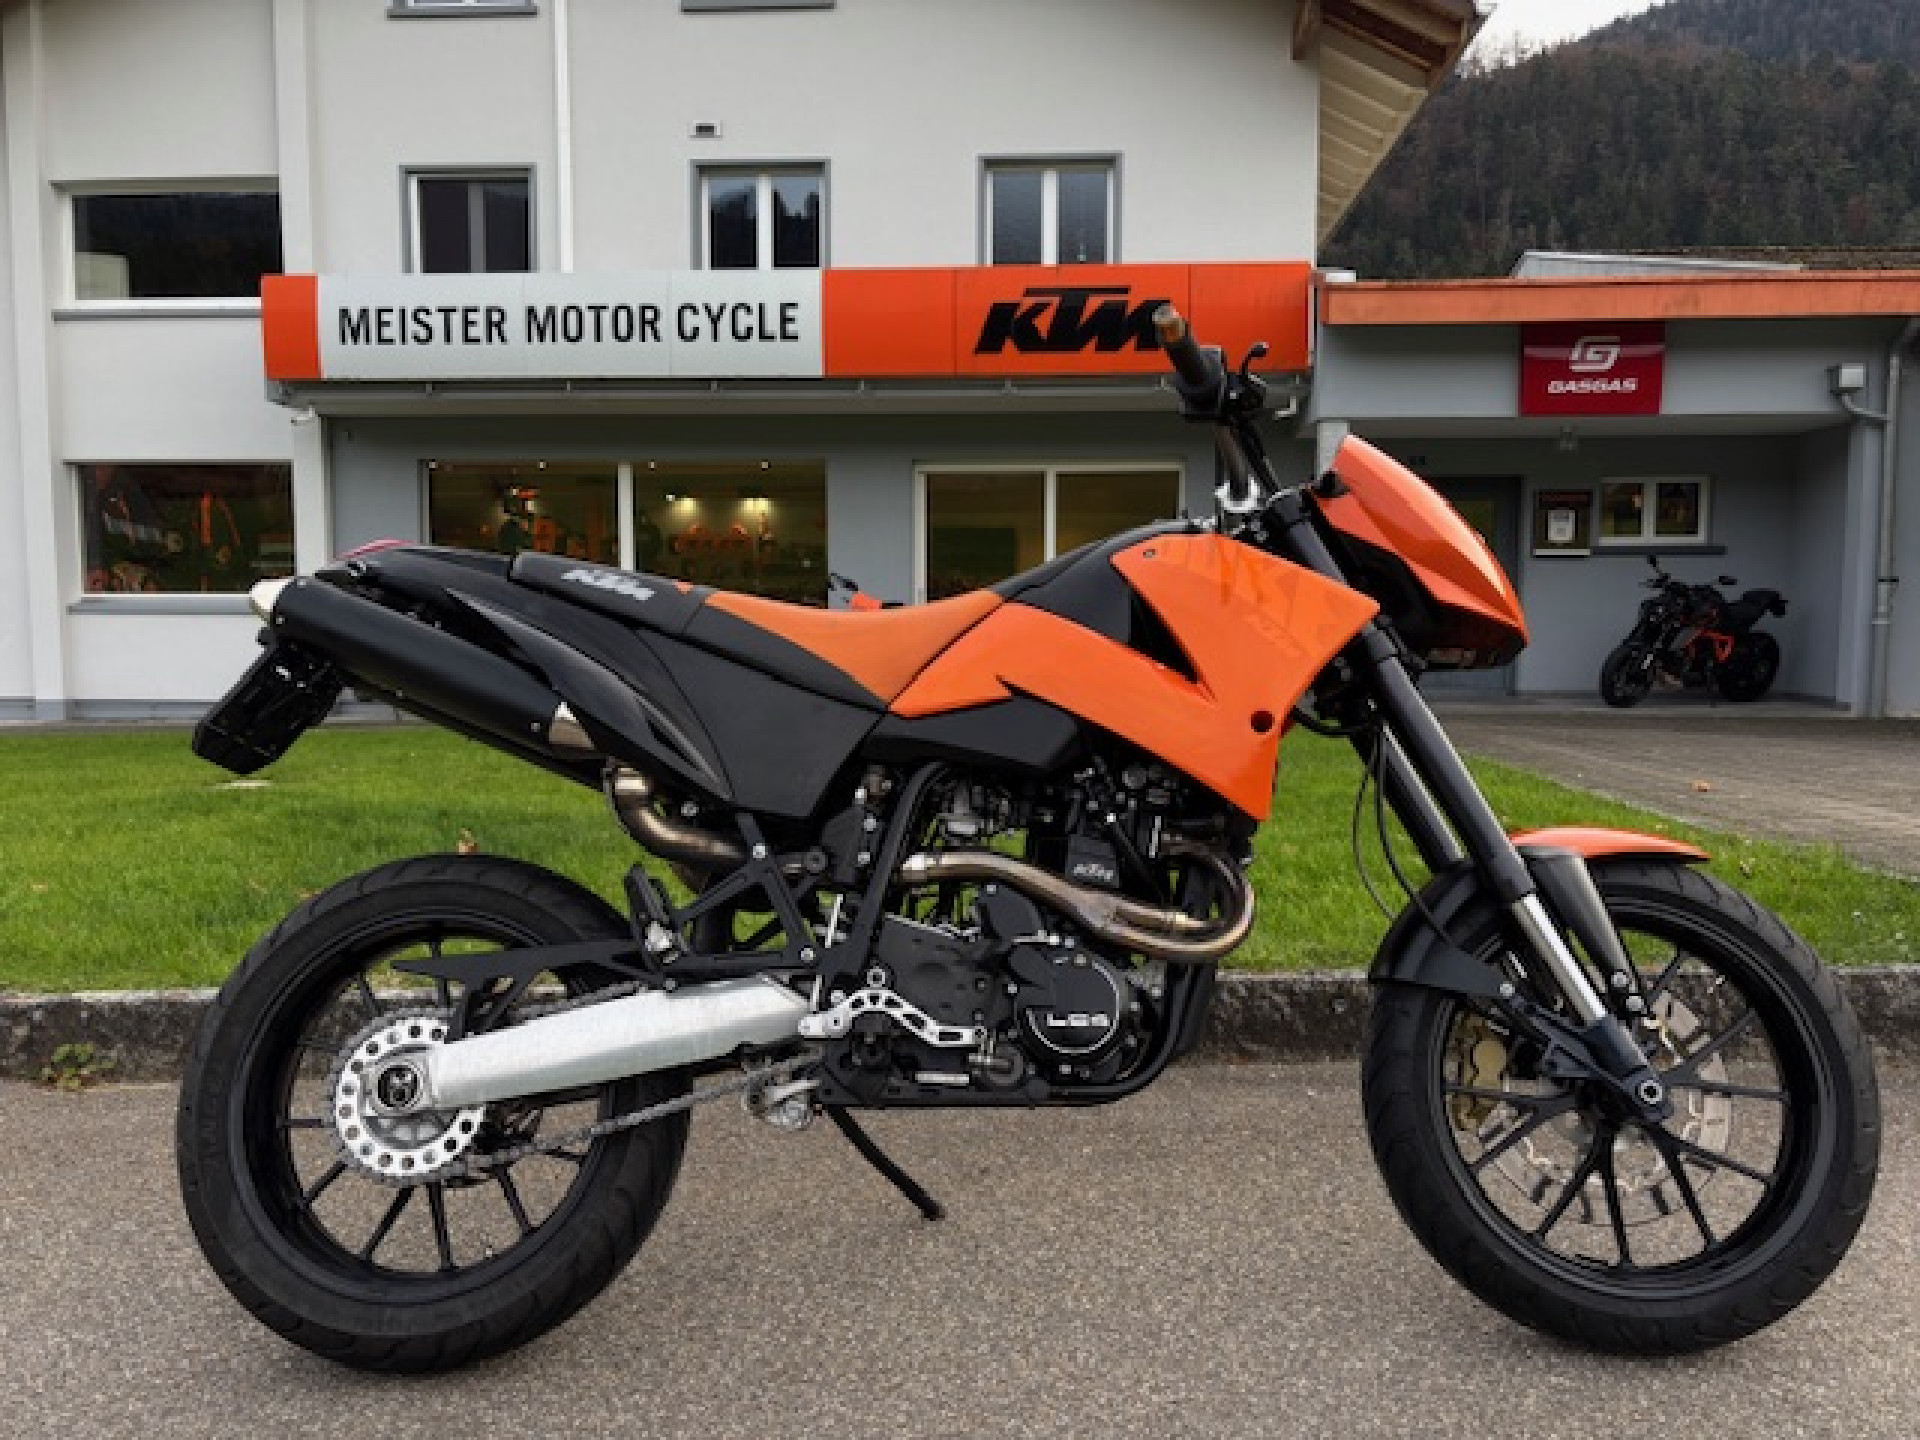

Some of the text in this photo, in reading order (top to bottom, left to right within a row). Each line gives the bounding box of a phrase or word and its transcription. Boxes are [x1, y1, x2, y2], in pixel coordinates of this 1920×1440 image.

[338, 302, 800, 346] MEISTER MOTOR CYCLE
[974, 286, 1171, 354] KTM
[1547, 377, 1639, 394] GASGAS
